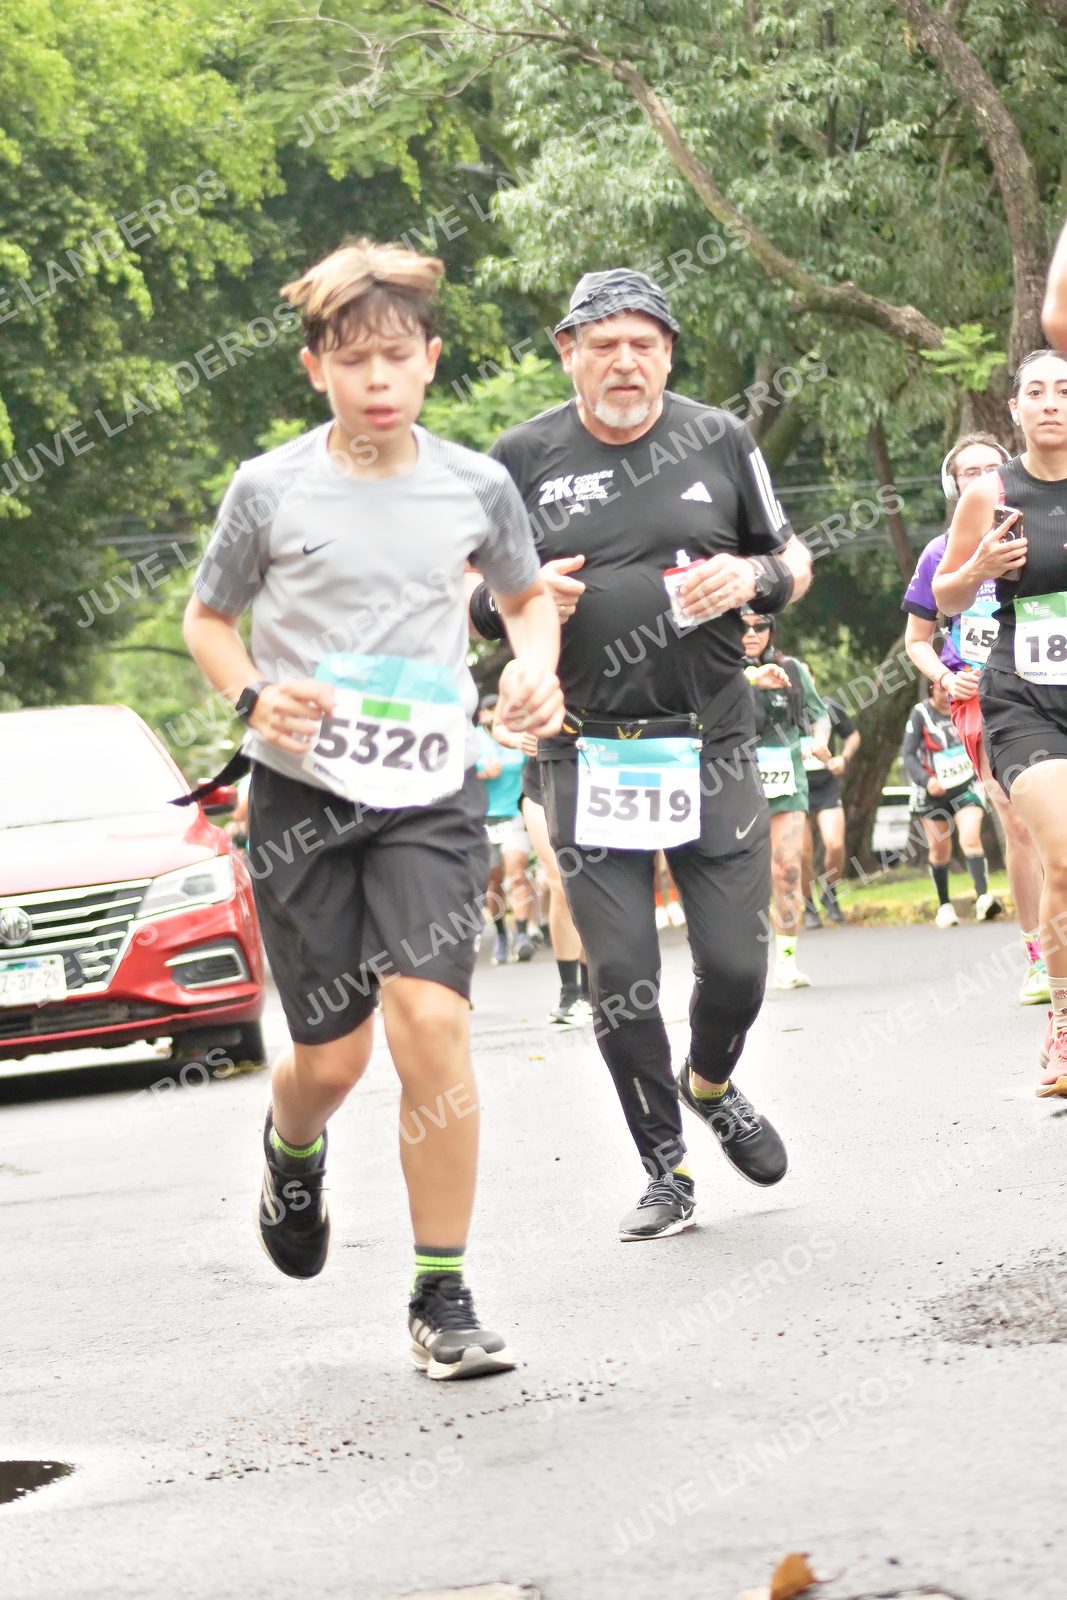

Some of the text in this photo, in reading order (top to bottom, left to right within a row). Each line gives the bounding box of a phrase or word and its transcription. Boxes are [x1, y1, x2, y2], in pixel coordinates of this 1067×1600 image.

[539, 474, 575, 506] 2K
[965, 627, 996, 648] 45
[1025, 633, 1067, 662] 18
[313, 716, 450, 773] 5320
[759, 770, 790, 785] 227
[586, 785, 692, 823] 5319
